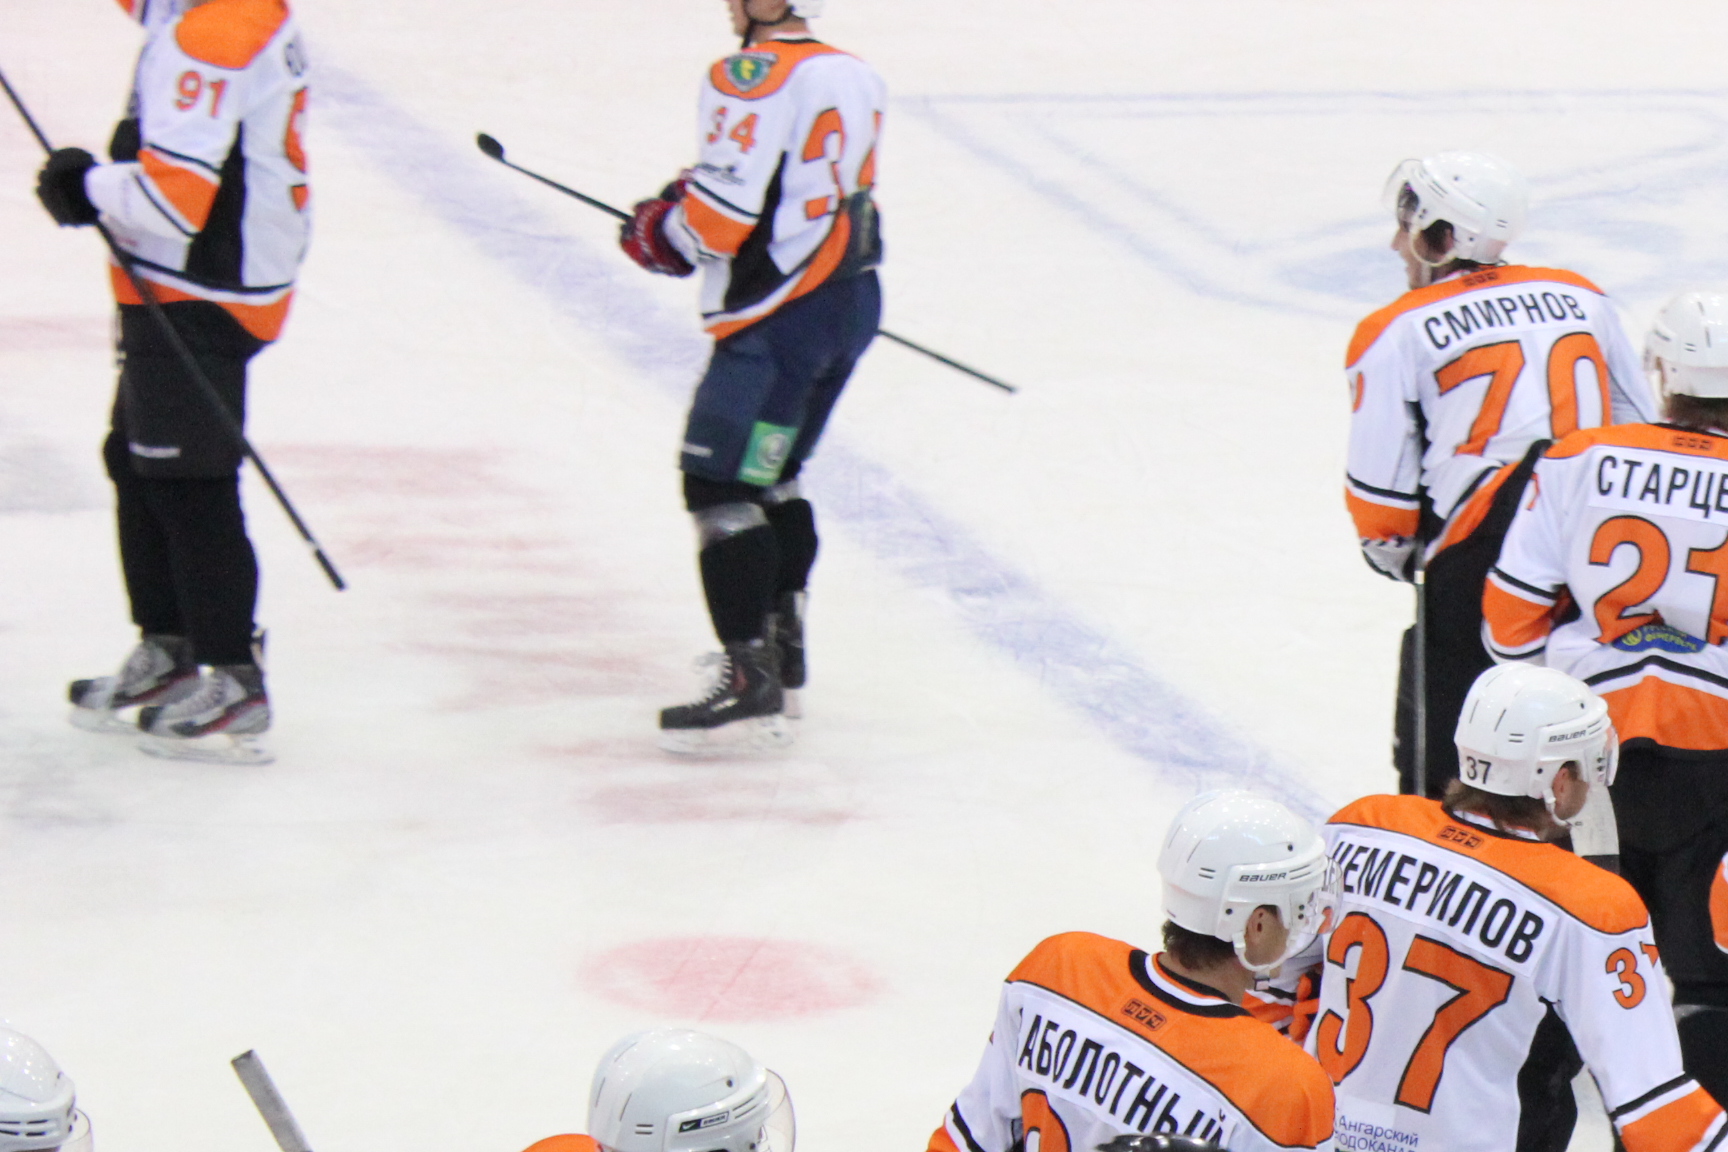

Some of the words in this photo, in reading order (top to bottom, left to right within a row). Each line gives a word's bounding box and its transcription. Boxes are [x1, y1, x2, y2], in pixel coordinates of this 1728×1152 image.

[174, 69, 228, 118] 91
[1423, 291, 1587, 350] СМИРНОВ
[1433, 330, 1613, 457] 70
[1548, 729, 1586, 743] BAUER
[1466, 755, 1492, 785] 37
[1238, 872, 1288, 882] BAUER
[1316, 910, 1515, 1115] 37
[1018, 1008, 1228, 1147] АБОЛОТНЫЙ
[1338, 1114, 1419, 1148] Ангарский
